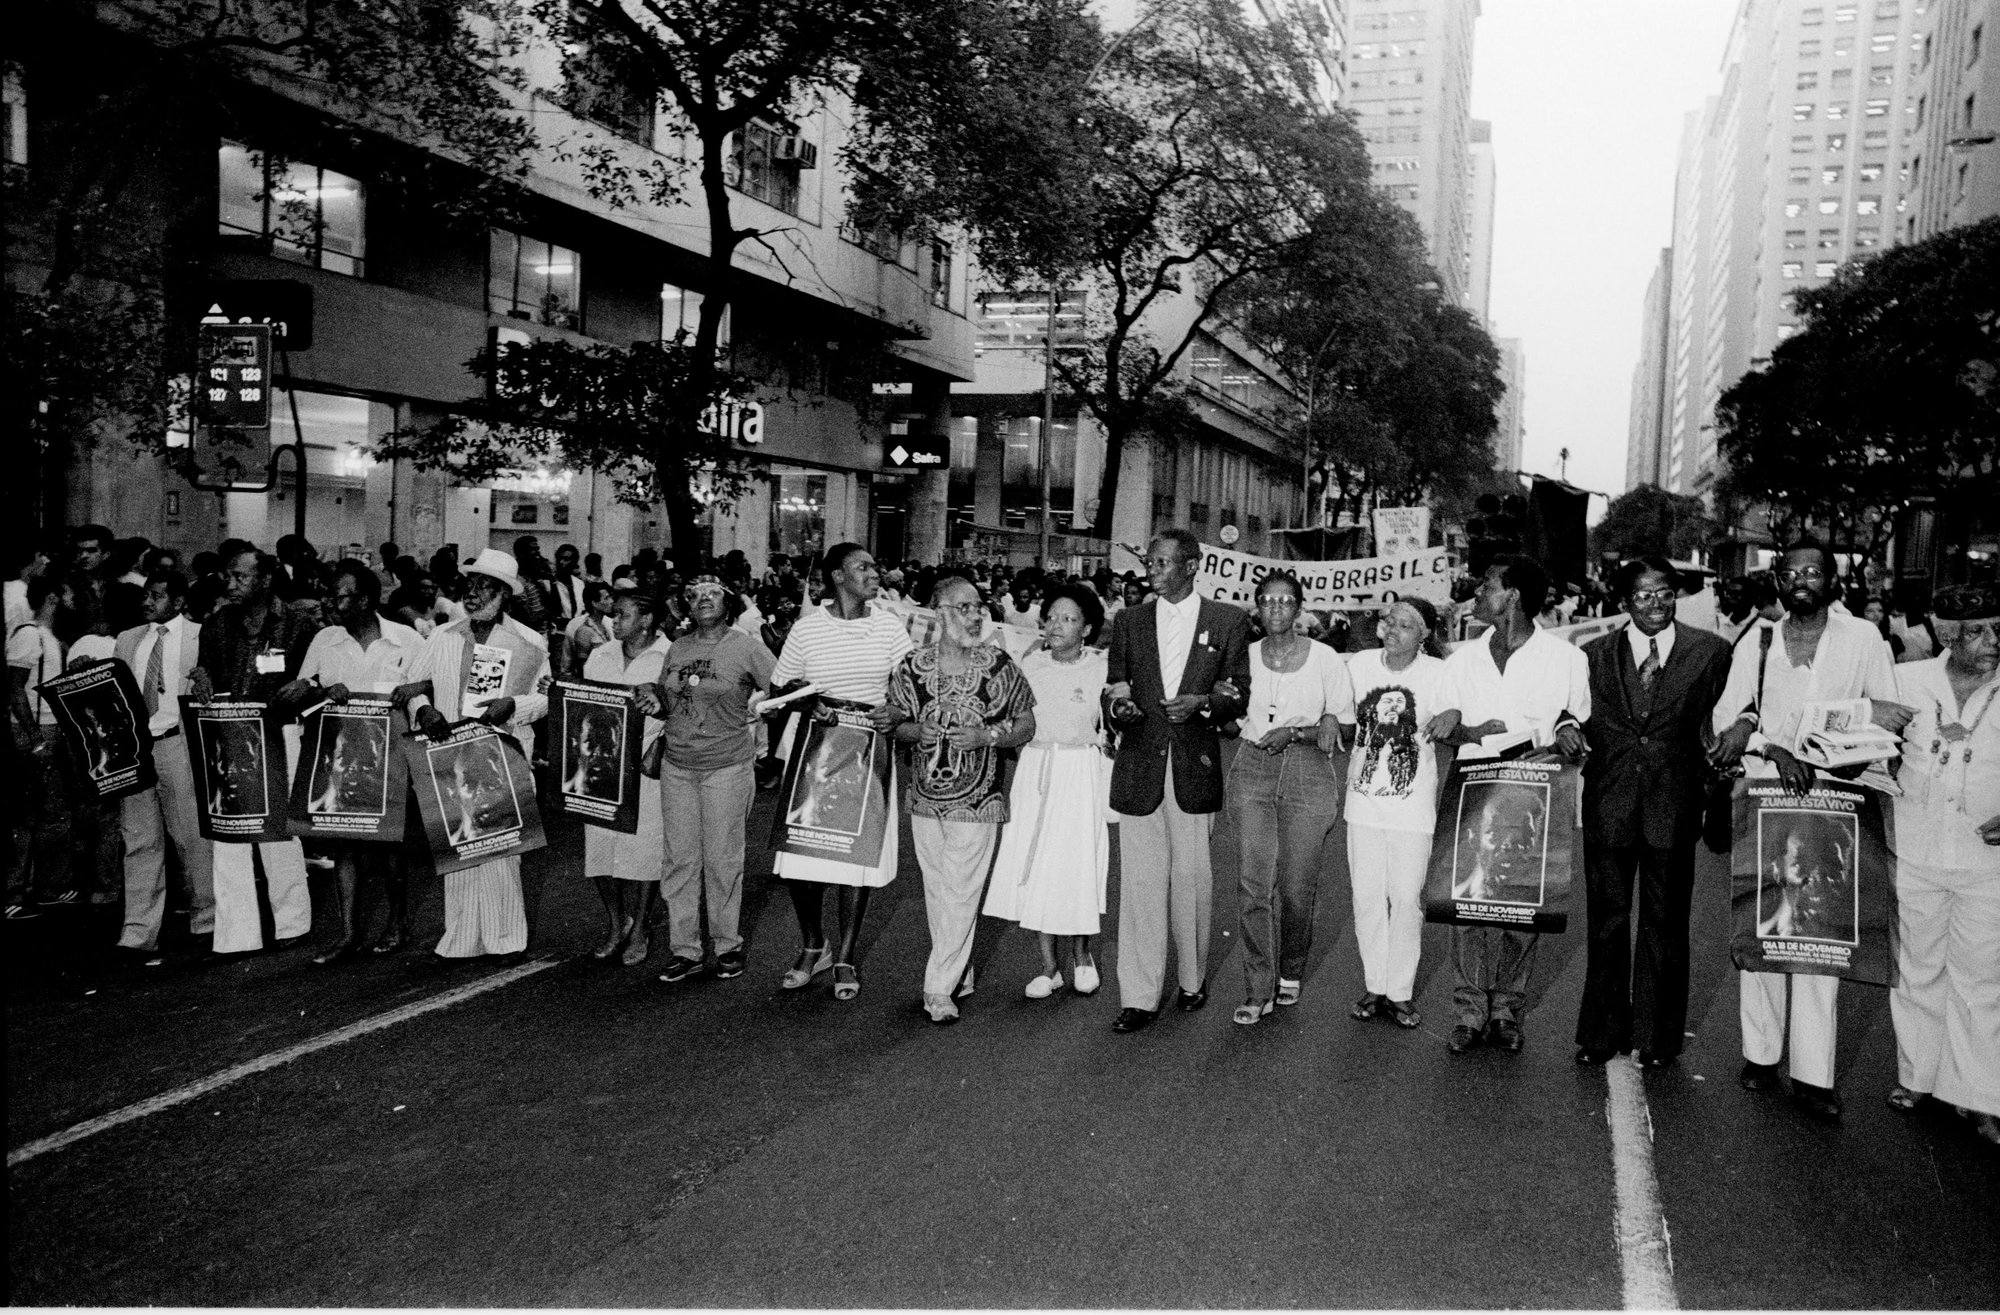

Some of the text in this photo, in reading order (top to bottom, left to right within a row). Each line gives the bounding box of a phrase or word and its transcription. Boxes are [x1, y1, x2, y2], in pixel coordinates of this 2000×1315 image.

[241, 368, 261, 381] 123
[208, 388, 228, 401] 127
[1301, 576, 1327, 589] NO
[1333, 559, 1423, 590] BRASIL
[856, 717, 874, 727] VIV
[1460, 764, 1489, 772] MARCHA
[1489, 761, 1518, 769] CONTRA
[1526, 762, 1562, 771] RACISMO
[1466, 769, 1549, 781] ZUMBI ESTÁ VIVO
[1748, 787, 1785, 796] MARCHA
[1822, 789, 1830, 797] O
[1830, 790, 1865, 802] RACISMO
[1760, 797, 1799, 807] ZUMBI
[1827, 799, 1855, 811] VIVO
[1490, 906, 1536, 916] NOVEMBRO
[1763, 941, 1851, 955] DIA 18 DE NOVEMBRO
